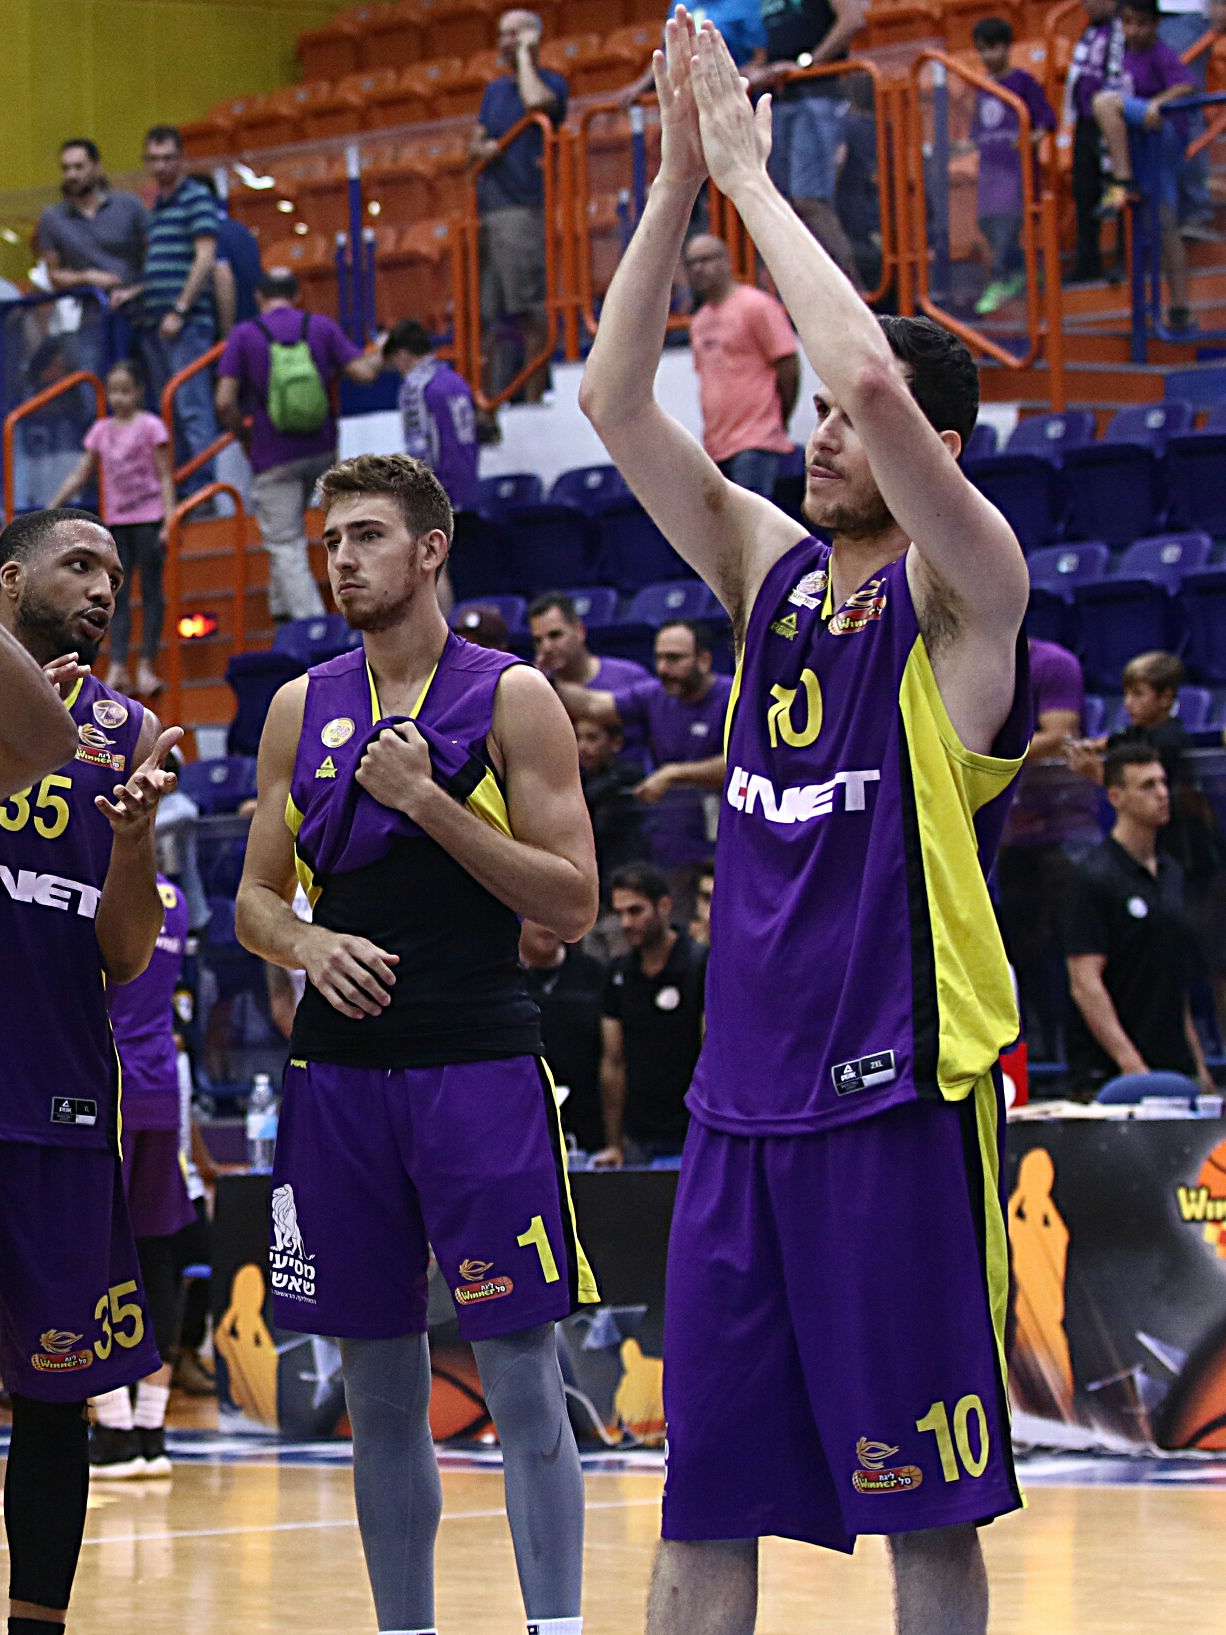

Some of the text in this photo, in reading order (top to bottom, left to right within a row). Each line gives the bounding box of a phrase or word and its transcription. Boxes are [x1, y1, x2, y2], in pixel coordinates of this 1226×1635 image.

[517, 1215, 560, 1284] 1
[460, 1286, 495, 1301] Winner
[94, 1280, 145, 1360] 35
[39, 1357, 78, 1369] Winner
[915, 1394, 990, 1483] 10
[859, 1475, 897, 1489] Winner
